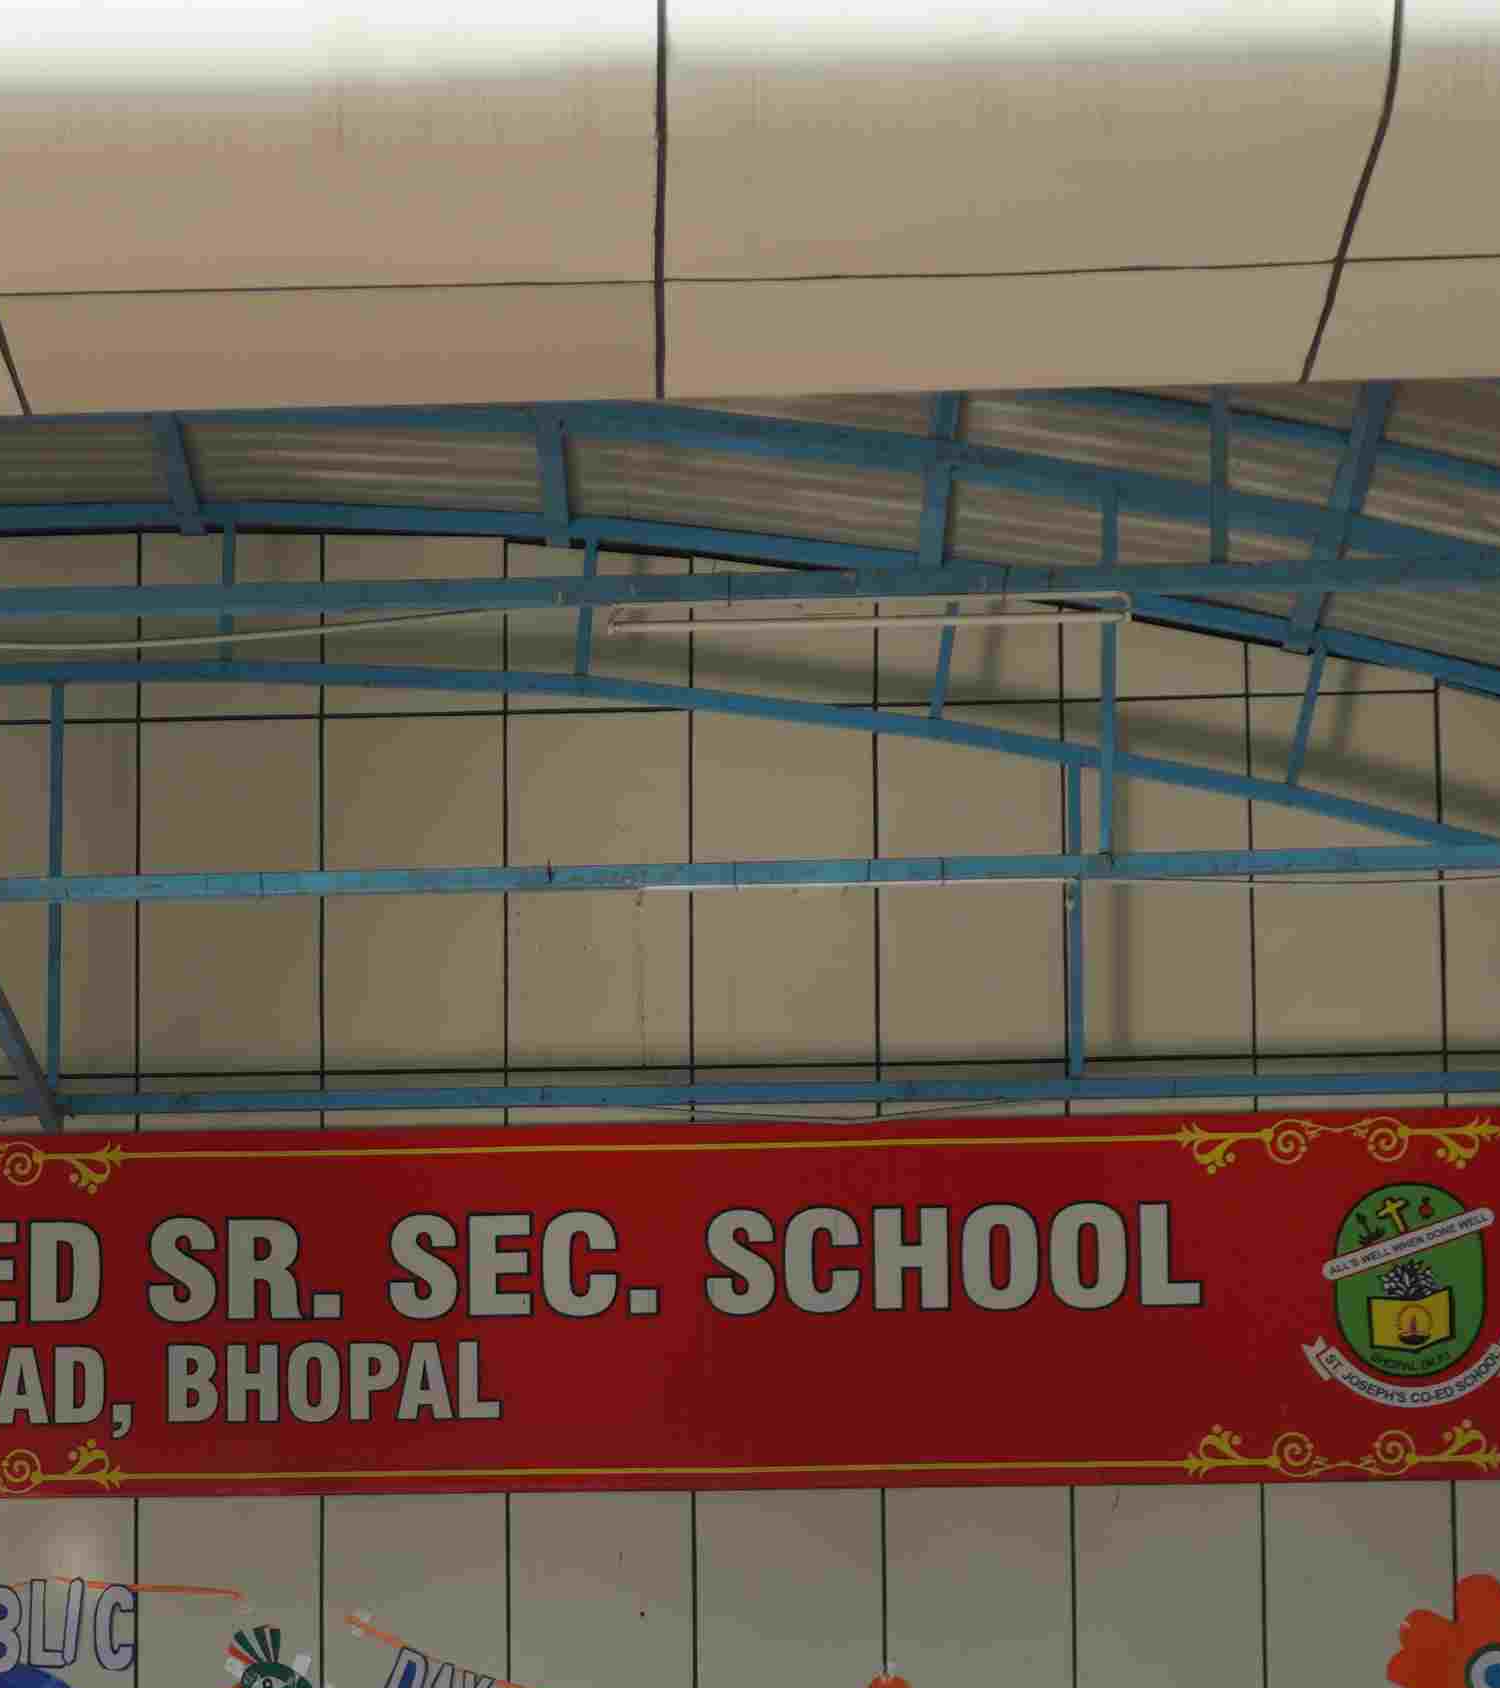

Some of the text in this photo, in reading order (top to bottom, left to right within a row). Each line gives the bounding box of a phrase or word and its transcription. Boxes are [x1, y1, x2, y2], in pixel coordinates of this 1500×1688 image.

[146, 1214, 344, 1323] SR.
[387, 1209, 660, 1321] SEC.
[704, 1201, 1204, 1317] SCHOOL
[165, 1339, 503, 1425] BHOPAL
[1409, 1386, 1455, 1403] CO-ED
[1454, 1352, 1500, 1392] SCHOOL
